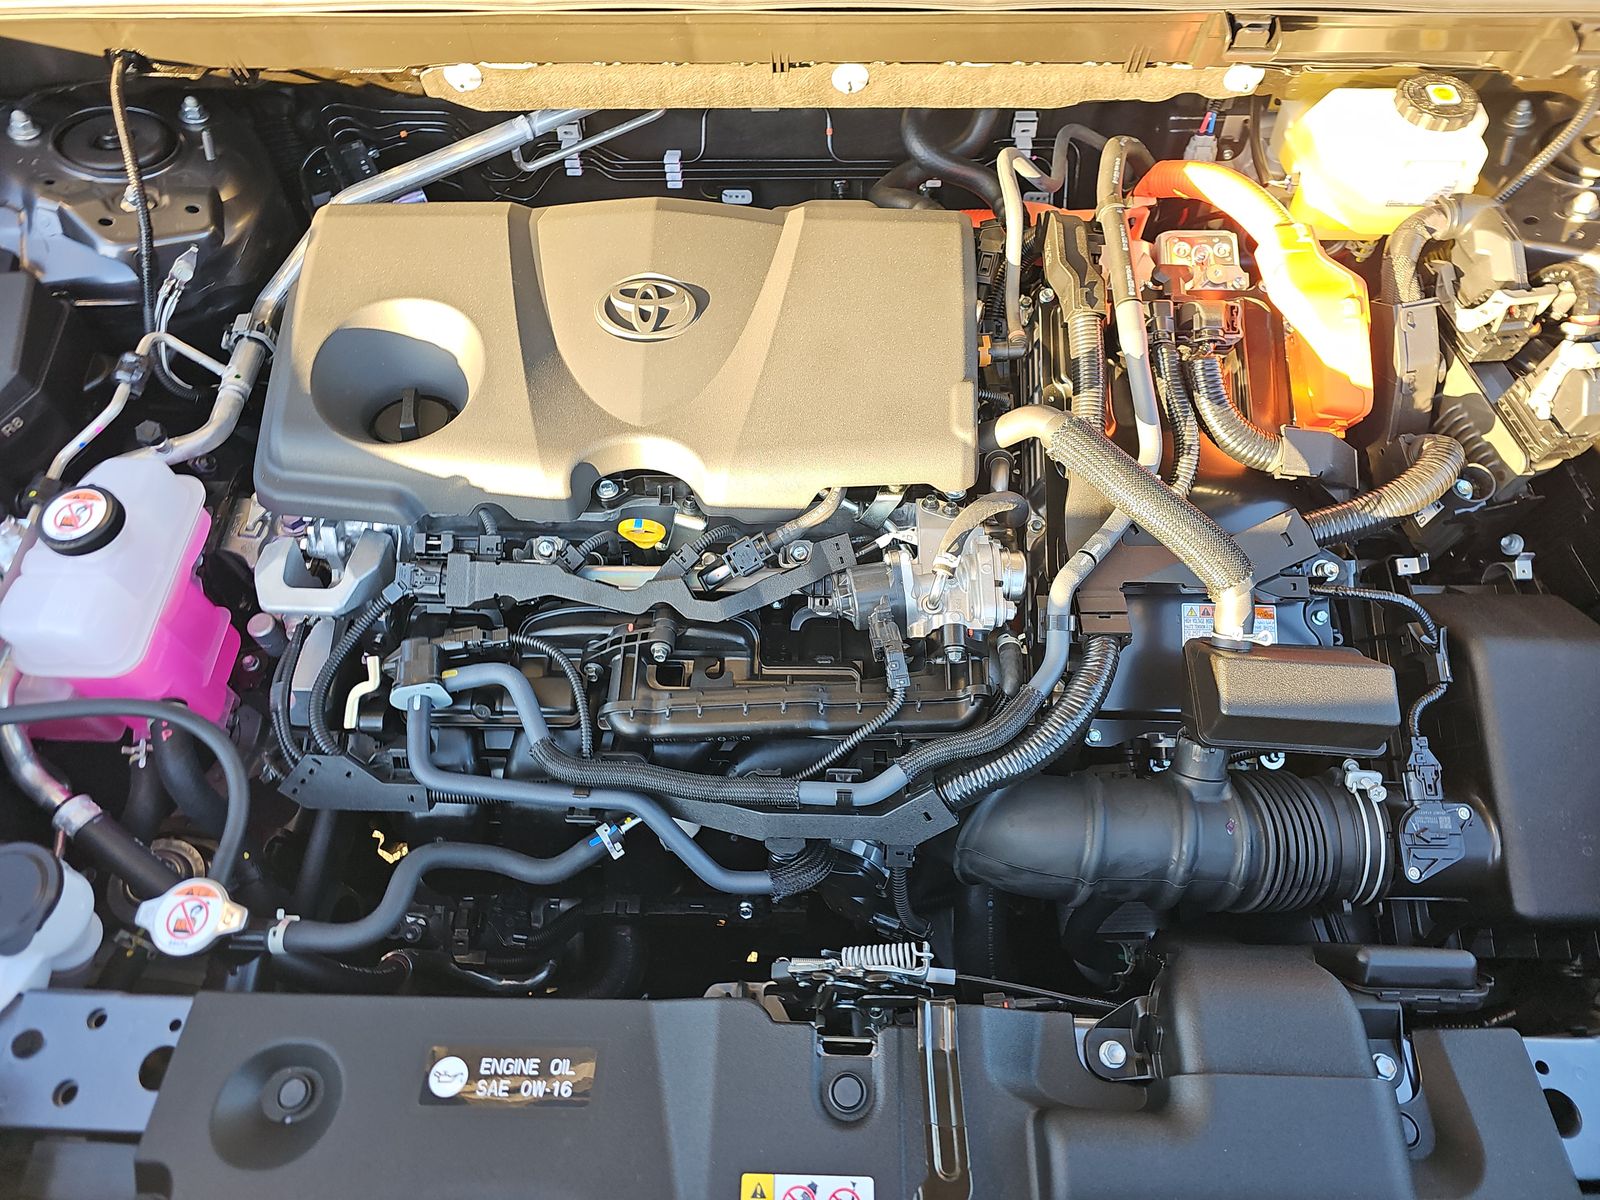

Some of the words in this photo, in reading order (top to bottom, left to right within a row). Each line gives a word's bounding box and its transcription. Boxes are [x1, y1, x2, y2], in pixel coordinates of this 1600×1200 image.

[479, 1057, 541, 1075] ENGINE
[549, 1058, 576, 1076] OIL
[475, 1079, 512, 1097] SAE
